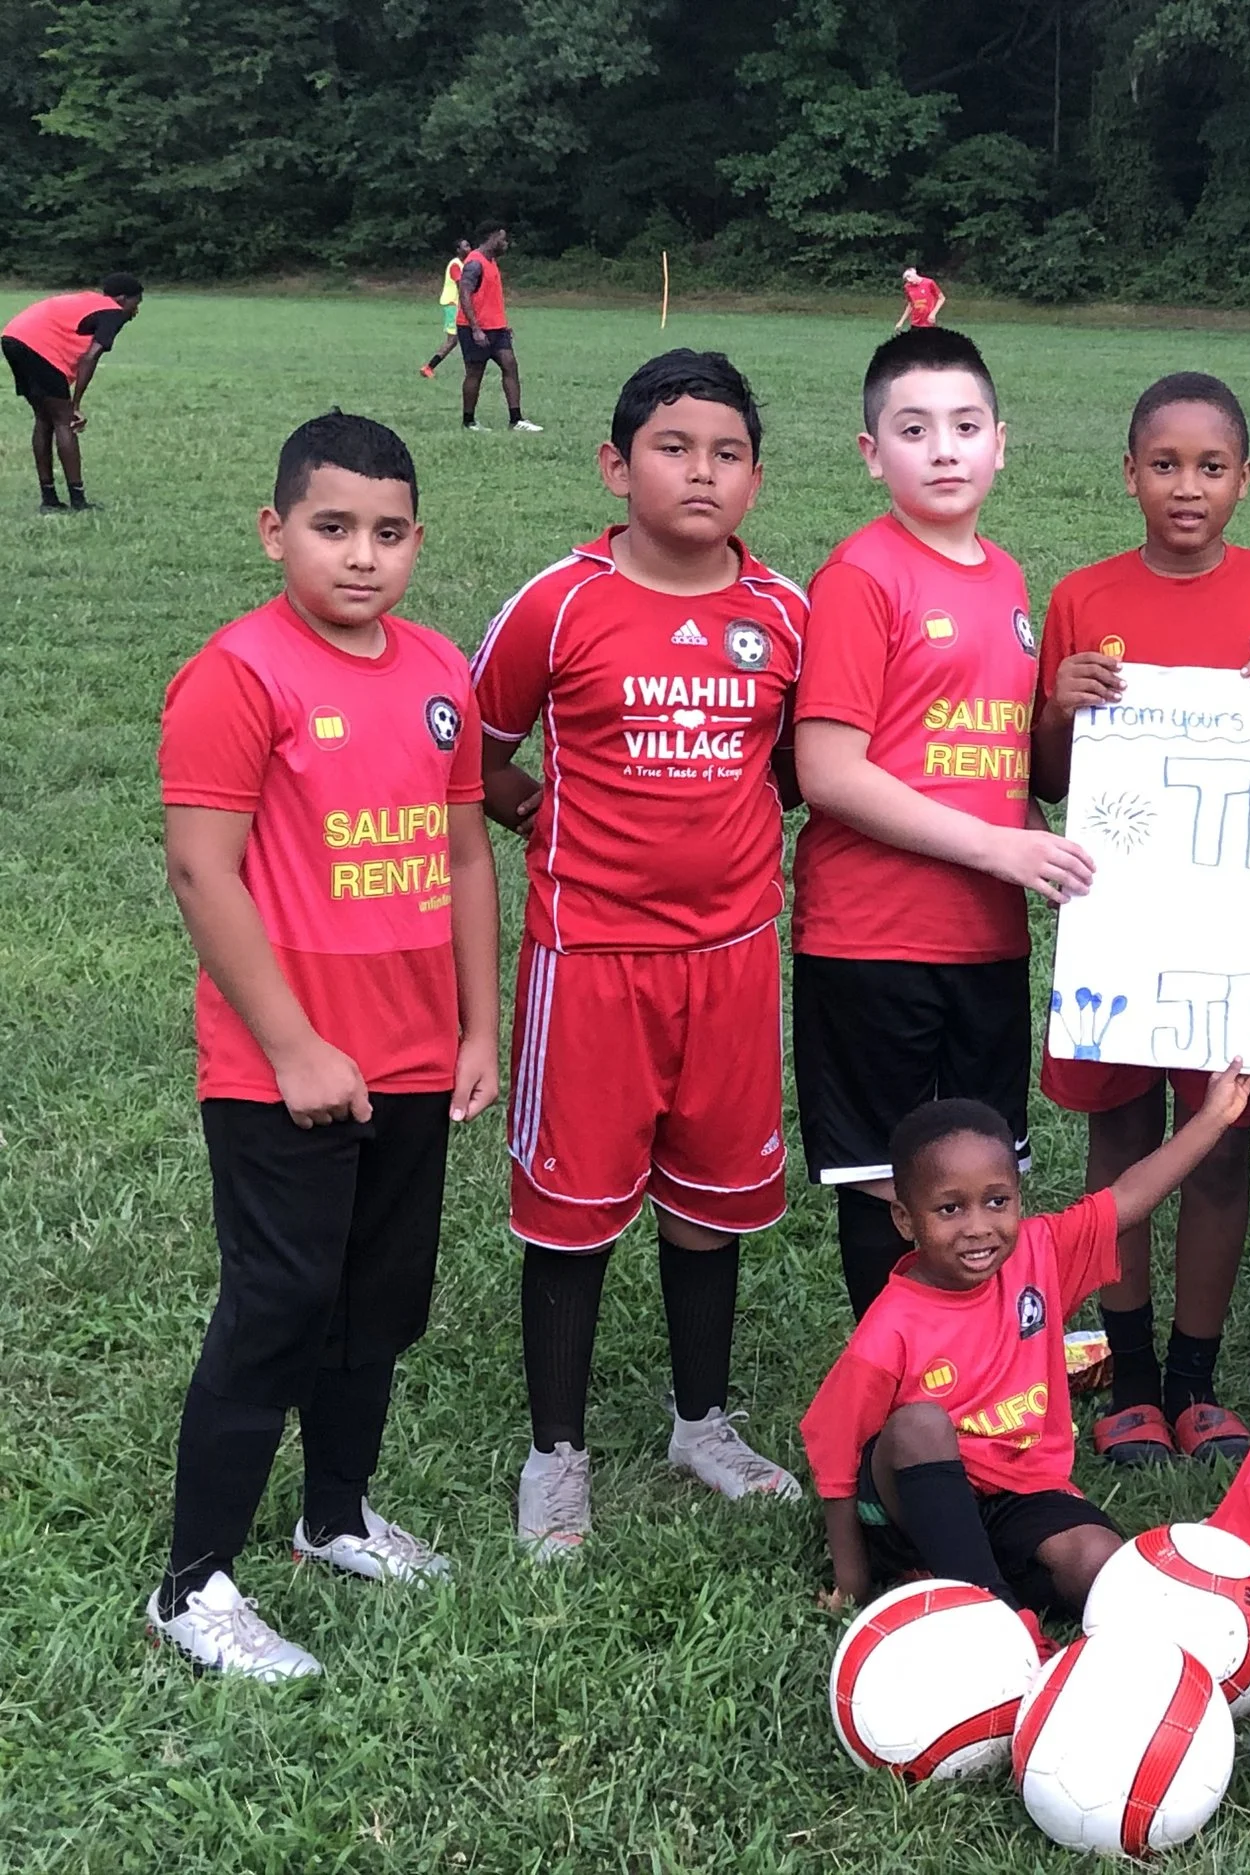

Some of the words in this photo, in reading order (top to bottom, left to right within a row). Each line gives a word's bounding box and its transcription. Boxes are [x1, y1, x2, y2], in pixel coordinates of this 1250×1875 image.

[623, 676, 756, 708] SWAHILI
[1171, 708, 1244, 738] yours
[623, 731, 745, 760] VILLAGE
[623, 764, 633, 776] A
[635, 765, 663, 778] True
[666, 766, 698, 779] Taste
[702, 764, 716, 783] of
[331, 850, 450, 899] RENTAL
[958, 1383, 1048, 1436] ALIFO
